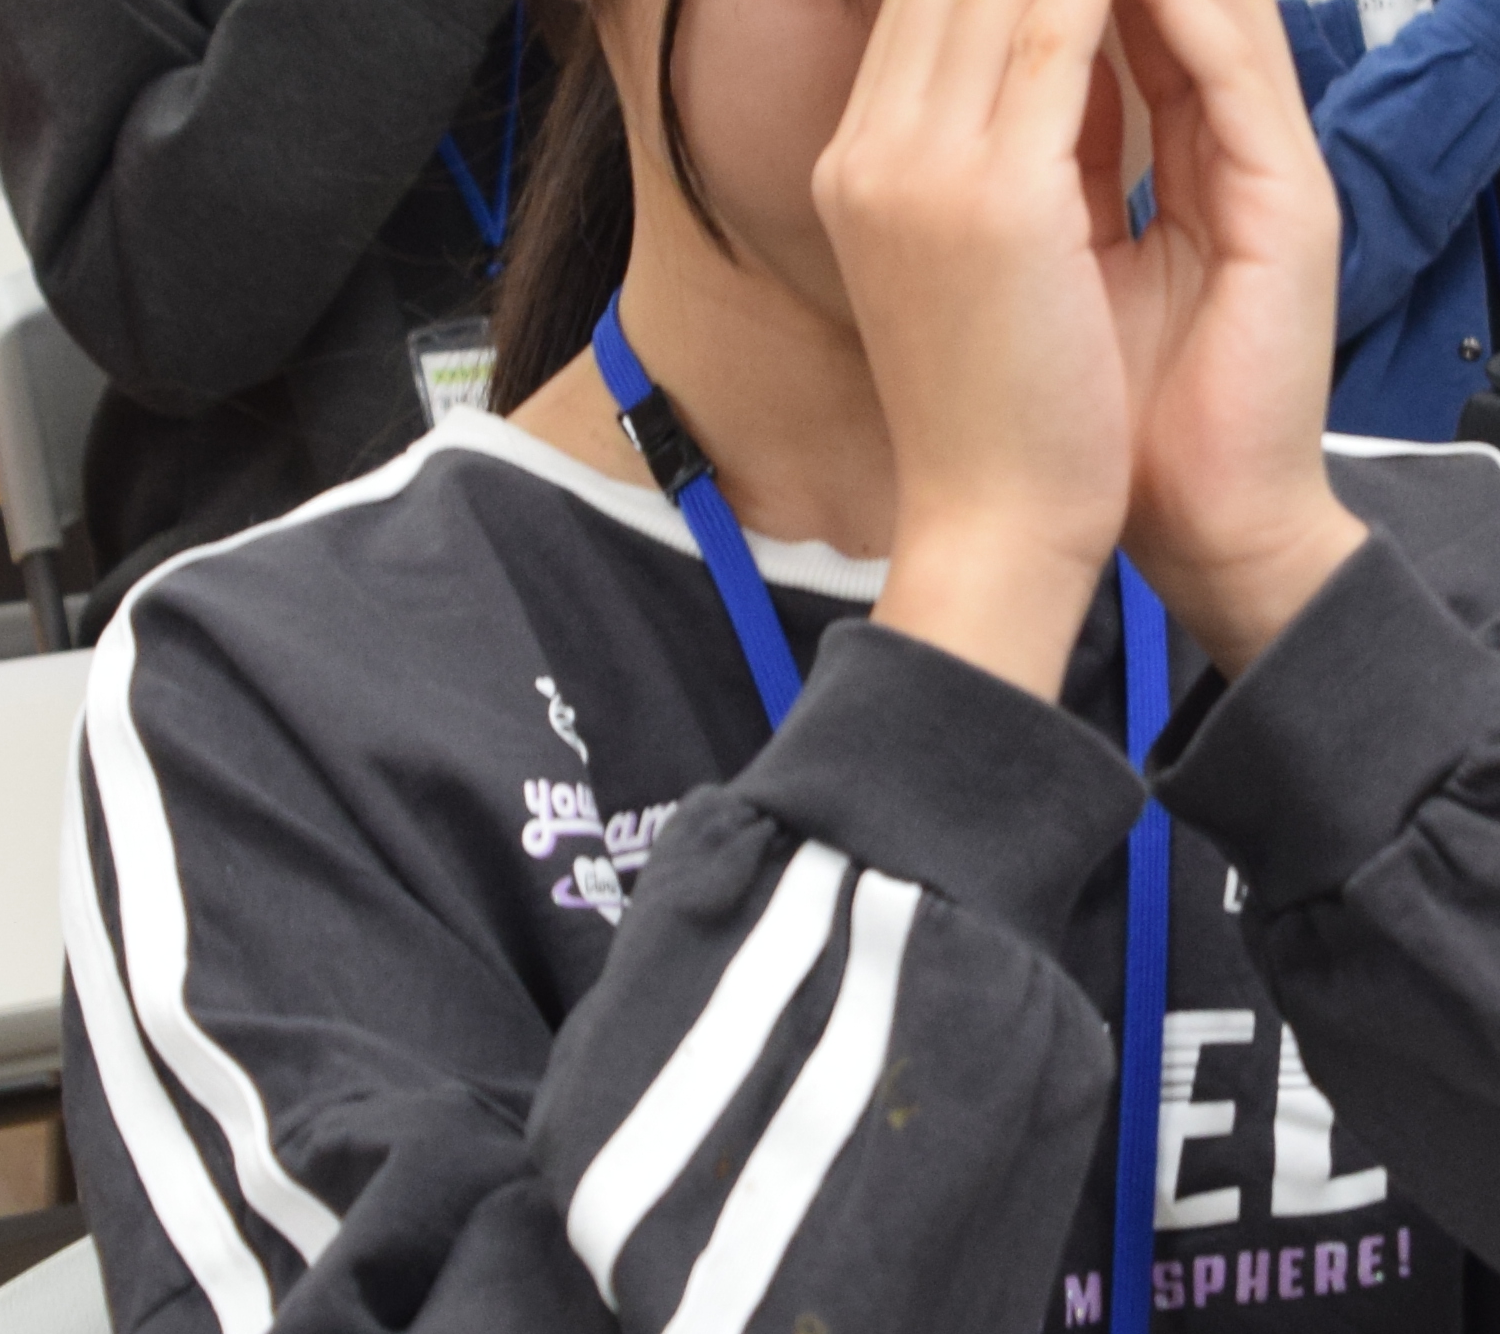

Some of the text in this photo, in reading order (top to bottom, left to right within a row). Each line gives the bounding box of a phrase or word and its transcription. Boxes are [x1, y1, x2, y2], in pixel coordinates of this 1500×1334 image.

[522, 777, 604, 860] you
[1152, 1009, 1388, 1231] EL
[1064, 1226, 1412, 1332] MSPHERE!
